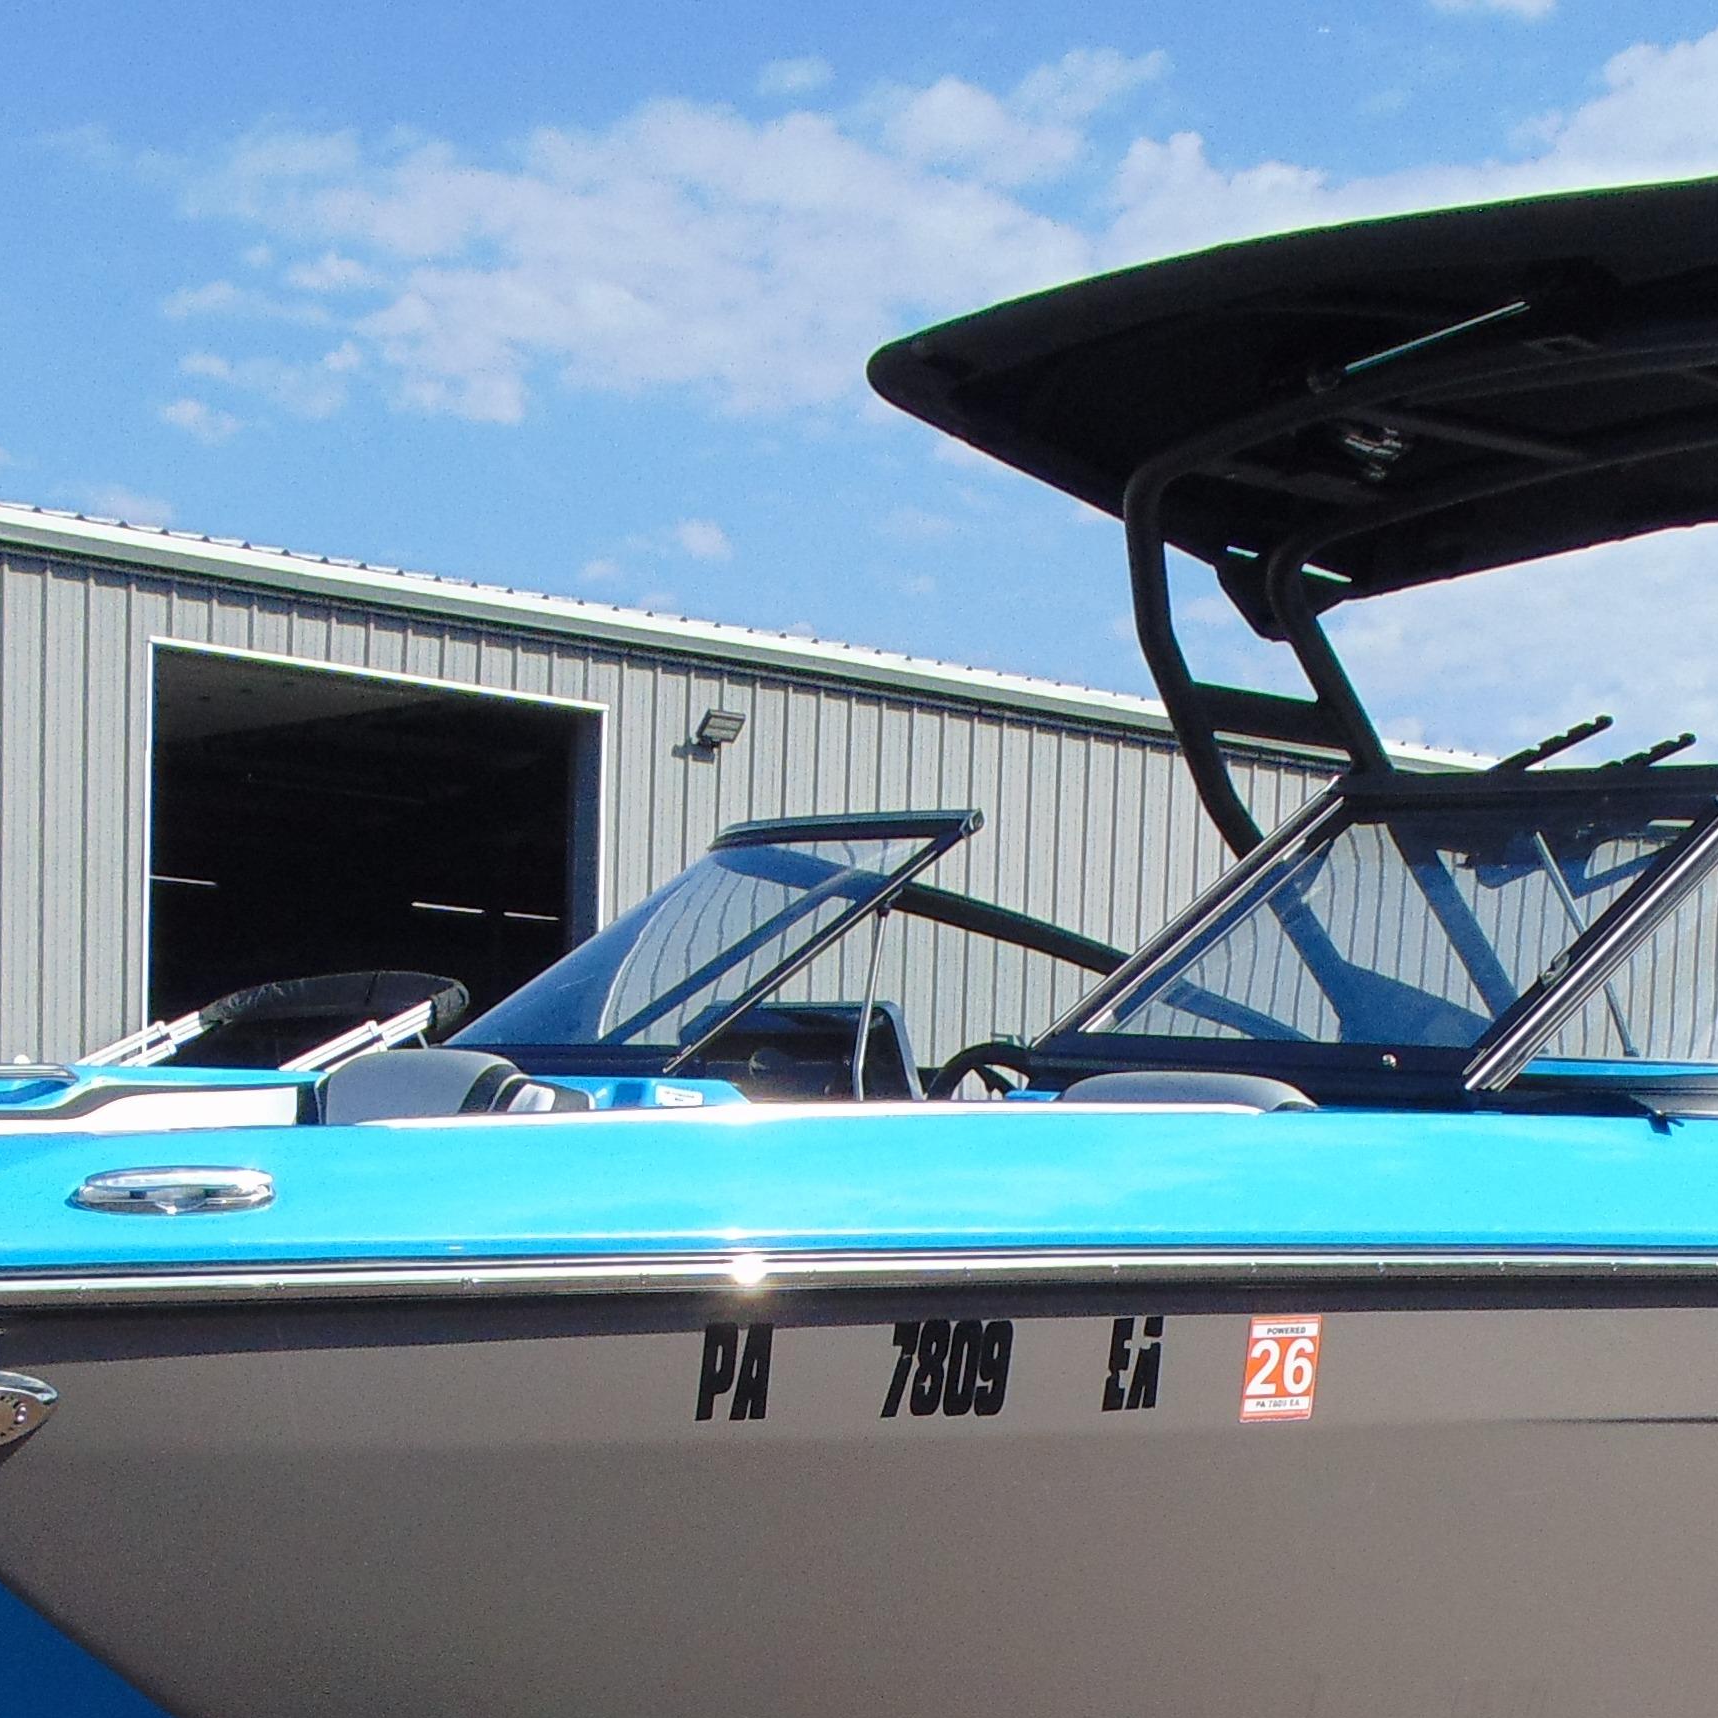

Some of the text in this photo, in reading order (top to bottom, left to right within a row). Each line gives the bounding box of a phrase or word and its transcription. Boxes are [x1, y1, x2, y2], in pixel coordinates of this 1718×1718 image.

[1266, 1326, 1307, 1335] POWERED
[695, 1316, 1164, 1422] PA 7809 EA
[1245, 1338, 1315, 1396] 26
